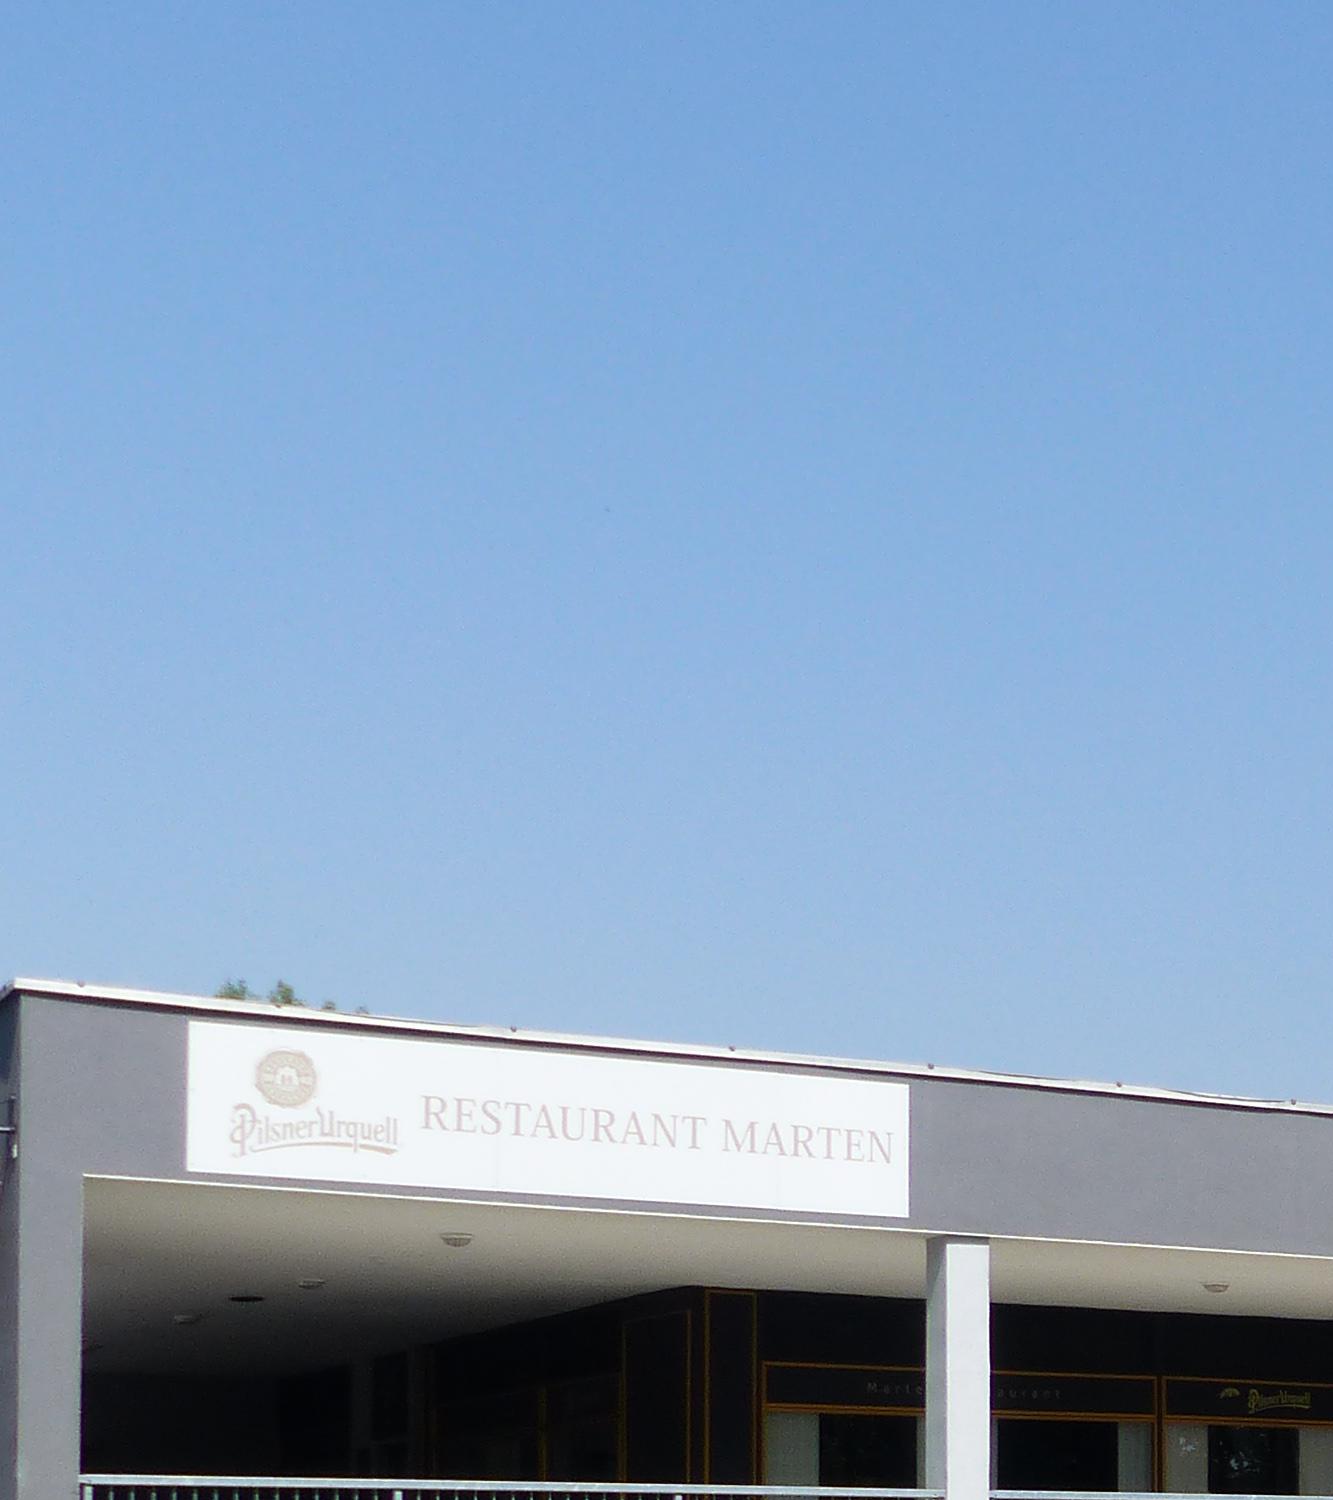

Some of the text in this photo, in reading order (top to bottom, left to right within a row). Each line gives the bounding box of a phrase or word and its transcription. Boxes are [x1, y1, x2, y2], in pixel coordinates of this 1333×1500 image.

[229, 1102, 400, 1157] Pilsner Urquell
[420, 1094, 894, 1165] RESTAURANT MARTEN
